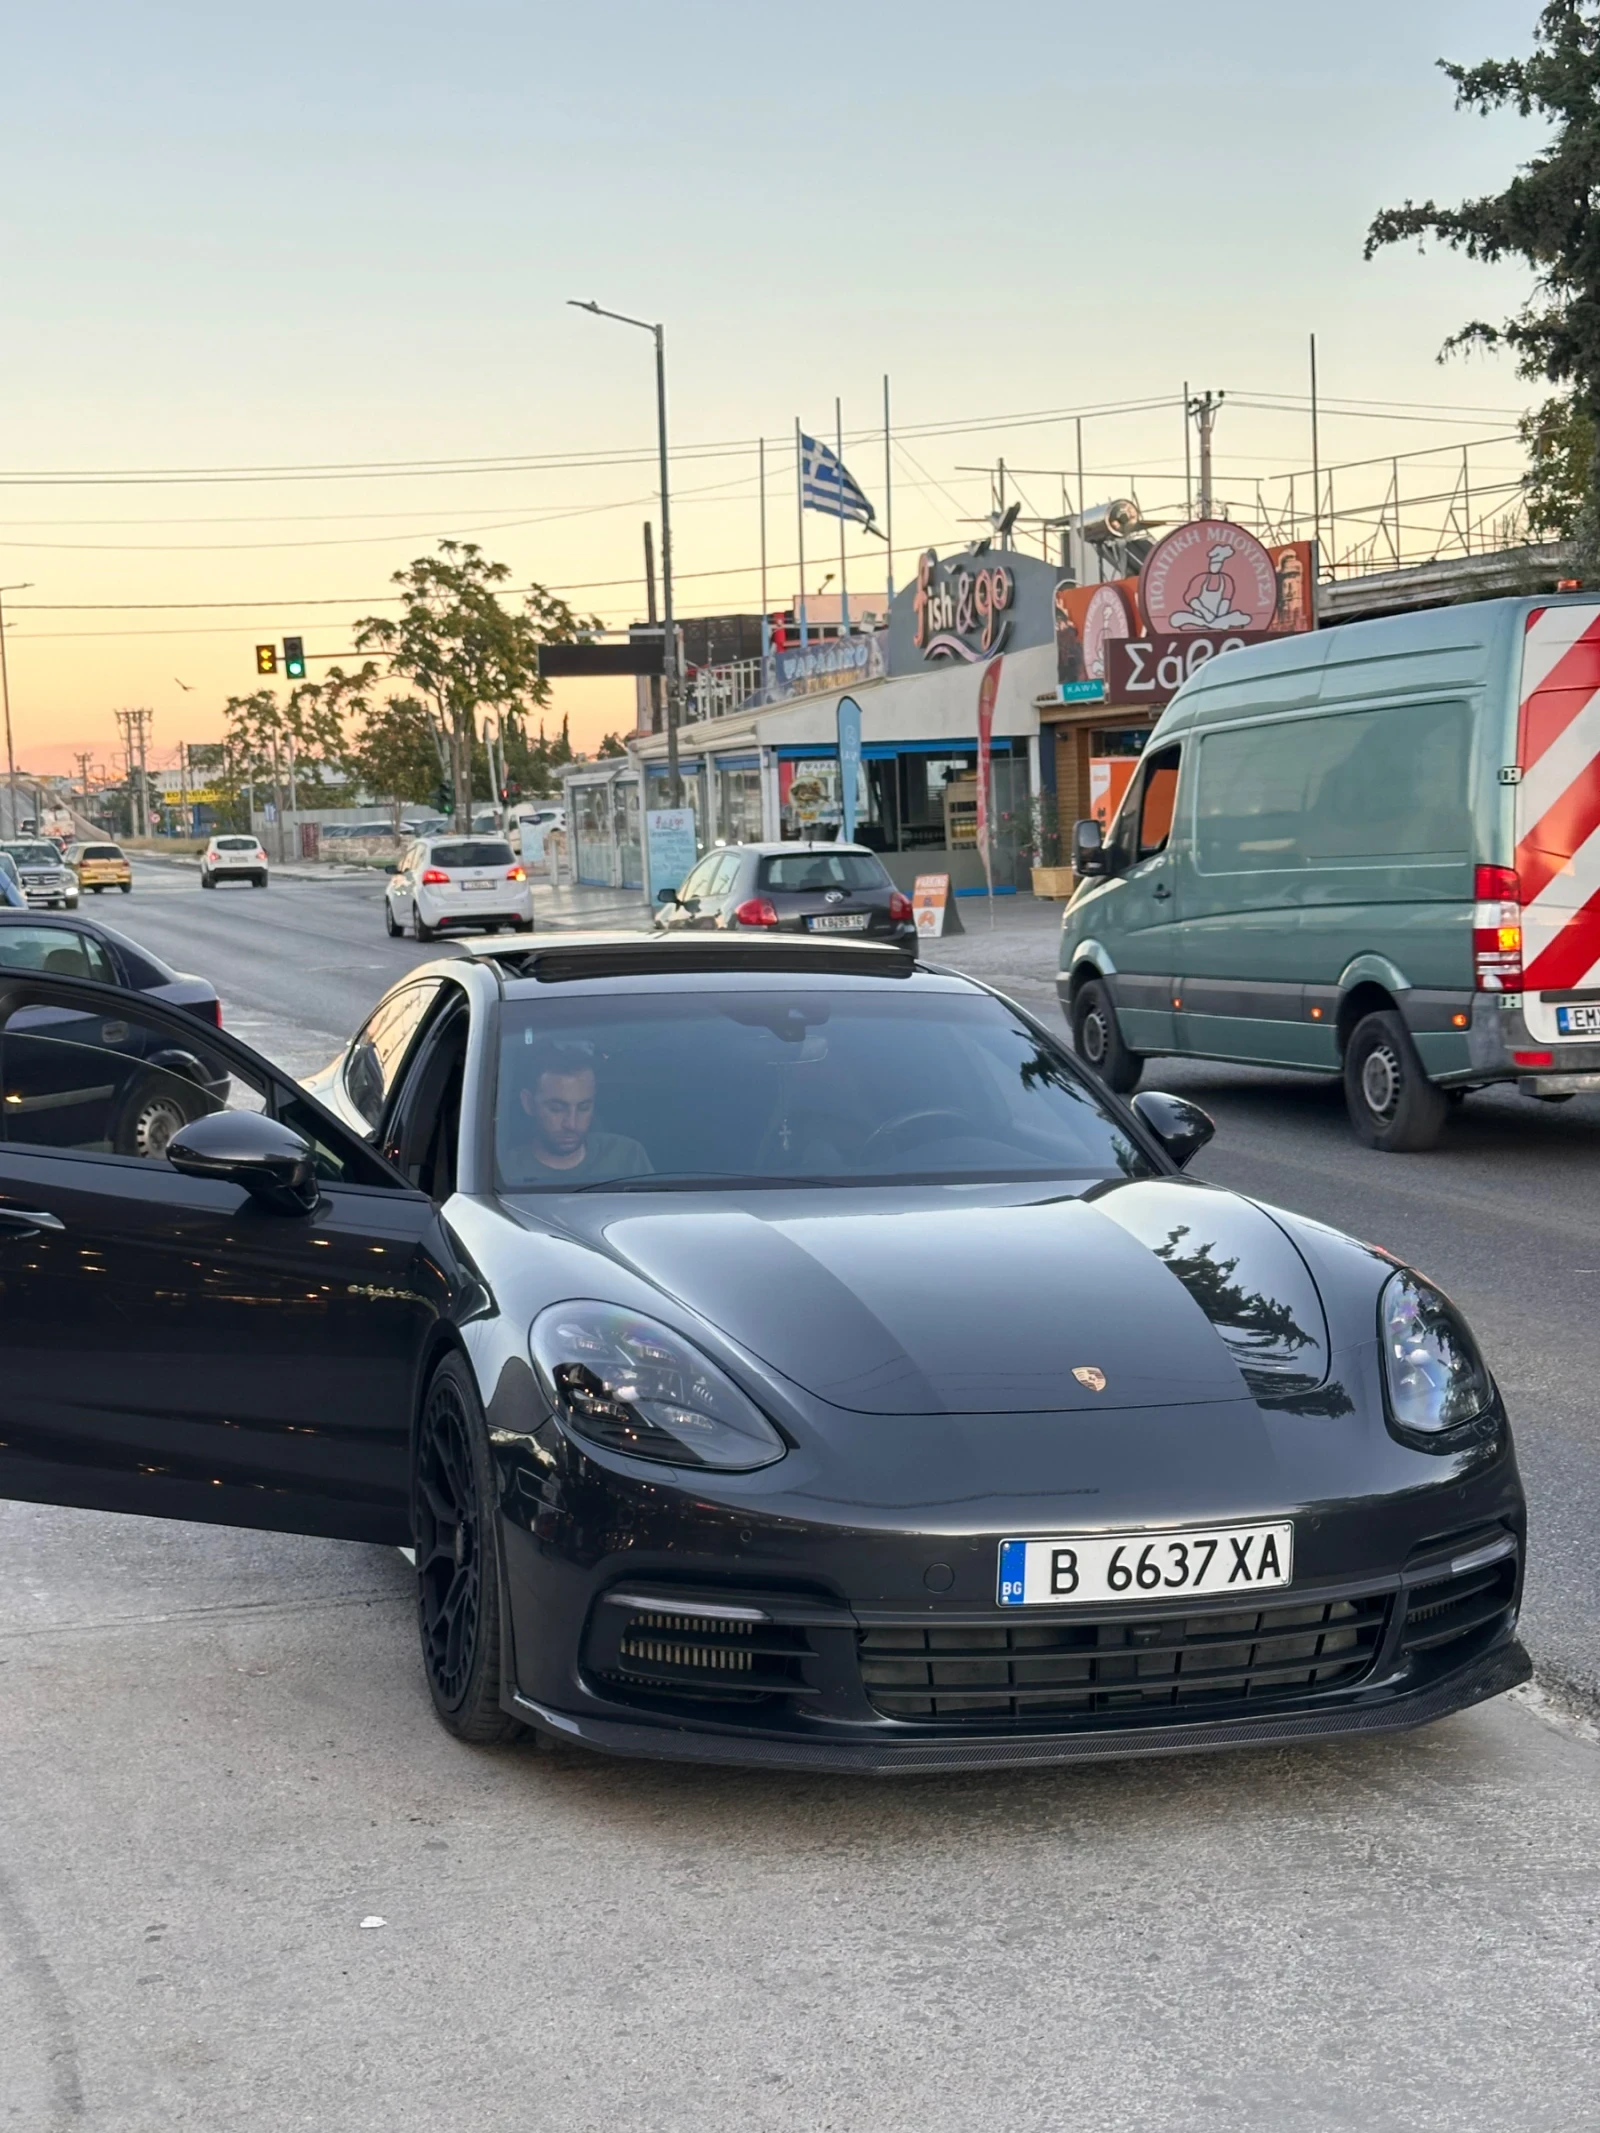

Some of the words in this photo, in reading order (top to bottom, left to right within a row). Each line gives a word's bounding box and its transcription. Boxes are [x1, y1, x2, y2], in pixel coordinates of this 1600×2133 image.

[1150, 529, 1201, 610] ΠΟΛΙΤΙΚΗ
[1206, 527, 1272, 607] ΜΠΟΥΓΑΤΣΑ
[913, 551, 953, 649] fish
[955, 571, 976, 635] &
[974, 566, 1010, 652] go
[783, 644, 868, 680] ΨΑΡΑΔΙΚΟ
[1002, 1581, 1022, 1596] BG
[1050, 1548, 1079, 1595] B
[1107, 1539, 1218, 1591] 6637
[1228, 1533, 1282, 1583] XA
